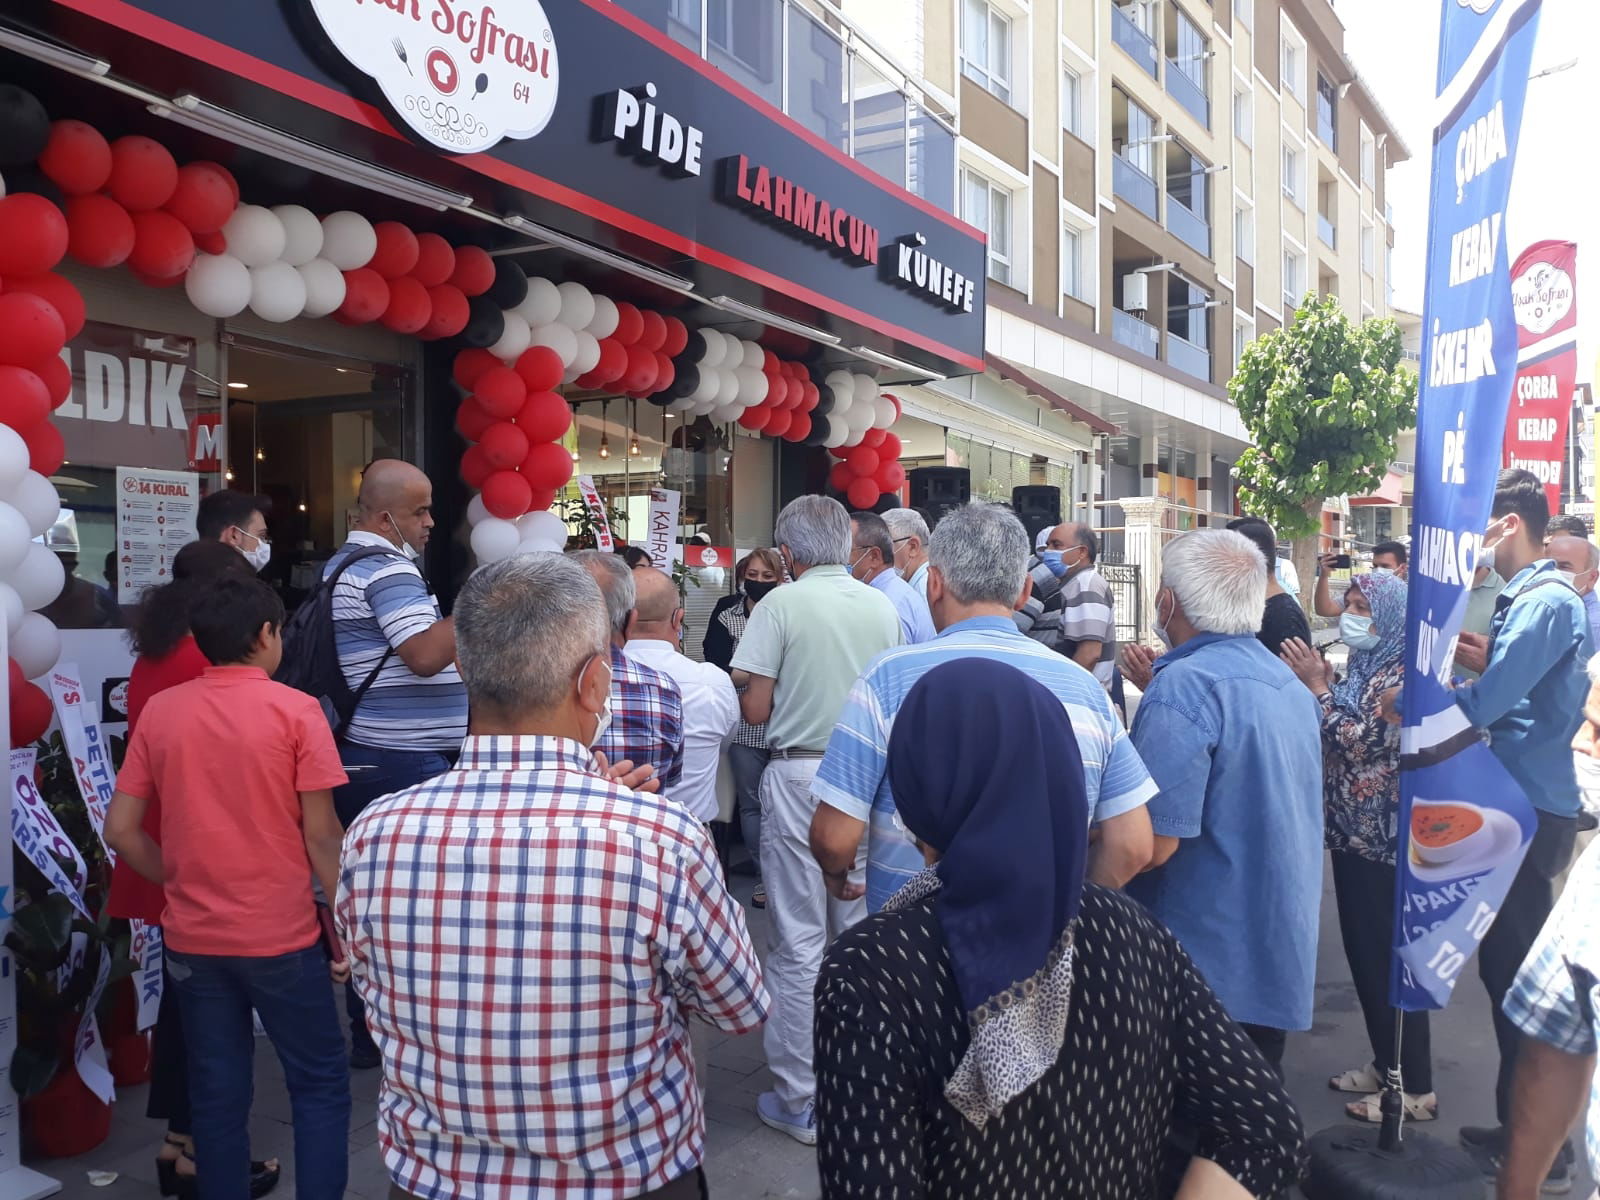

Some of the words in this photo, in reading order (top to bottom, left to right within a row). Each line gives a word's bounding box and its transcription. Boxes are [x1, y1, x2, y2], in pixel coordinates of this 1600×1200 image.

[513, 82, 530, 104] 64
[614, 82, 704, 177] PİDE
[736, 153, 879, 265] LAHMACUN
[898, 231, 974, 313] KÜNEFE
[1517, 374, 1559, 407] ÇORBA
[1518, 417, 1557, 441] KEBAP
[139, 482, 152, 495] 14
[153, 484, 190, 497] KURAL
[74, 757, 104, 824] AZİZ
[84, 724, 113, 816] PETE
